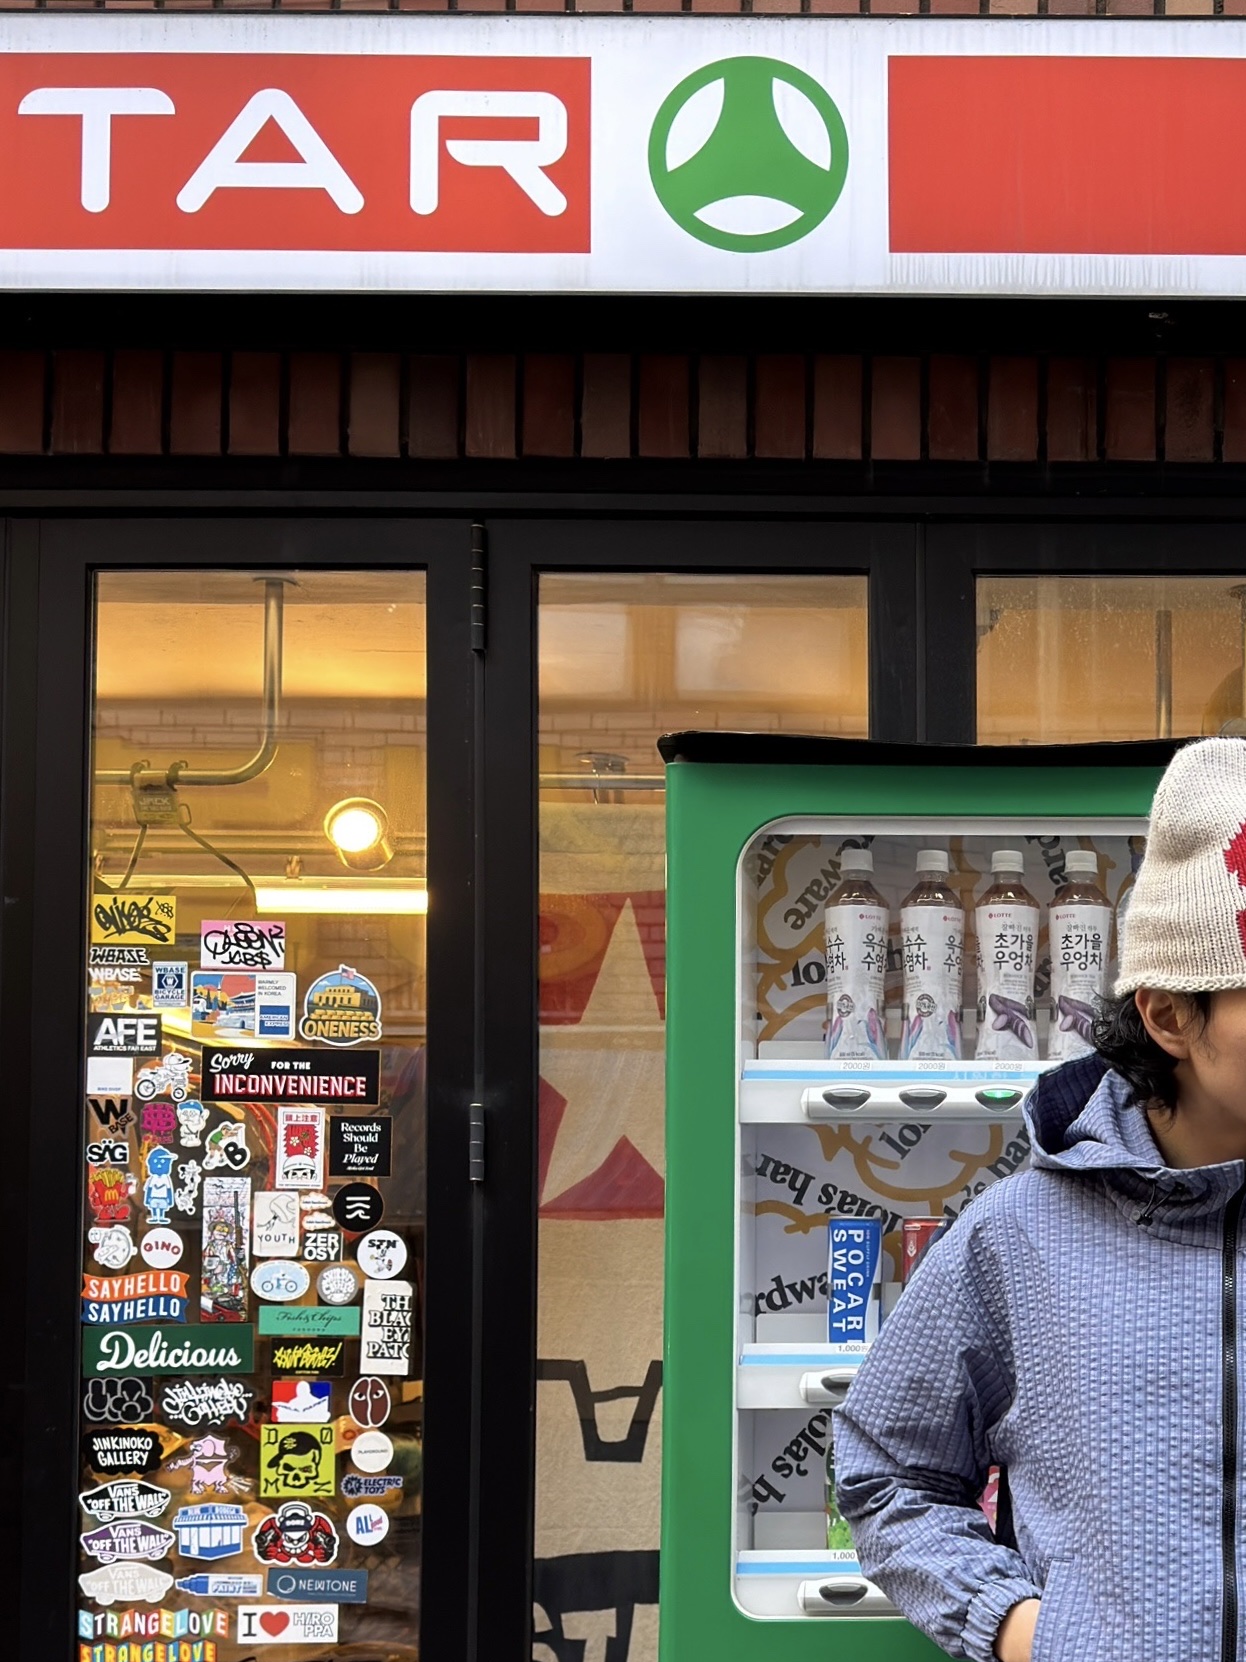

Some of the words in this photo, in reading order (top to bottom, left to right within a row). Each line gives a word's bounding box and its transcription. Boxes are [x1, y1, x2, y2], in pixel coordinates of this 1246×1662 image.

[18, 88, 567, 215] TAR
[993, 932, 1034, 951] 초가을
[1060, 933, 1103, 951] 초가을
[993, 951, 1033, 971] 우엉차
[1060, 951, 1103, 971] 우엉차
[155, 966, 186, 974] WBASE
[93, 1017, 157, 1046] AFE
[304, 1020, 378, 1038] ONENESS
[209, 1052, 255, 1073] Sorry
[270, 1061, 291, 1070] FOR
[292, 1061, 312, 1070] THE
[842, 1062, 870, 1070] 2000원
[918, 1062, 945, 1070] 2000원
[994, 1062, 1023, 1071] 2000원
[213, 1073, 367, 1097] INCONVENIENCE
[340, 1122, 382, 1132] Records
[343, 1133, 379, 1143] Should
[354, 1143, 368, 1154] Be
[342, 1153, 380, 1165] Played
[257, 1233, 296, 1244] YOUTH
[304, 1233, 339, 1247] ZER
[143, 1240, 181, 1255] GINO
[304, 1247, 339, 1261] OSY
[88, 1274, 181, 1300] SAYHELLO
[832, 1228, 848, 1333] SWEAT
[88, 1298, 181, 1323] SAYHELLO
[382, 1326, 411, 1343] EY
[96, 1330, 242, 1371] Delicious
[92, 1436, 153, 1451] JINKINOKO
[97, 1450, 149, 1467] GALLERY
[363, 1477, 402, 1488] ELECTRIC
[107, 1484, 140, 1498] VANS
[364, 1486, 386, 1495] TOYS
[112, 1496, 135, 1513] THE
[109, 1524, 142, 1538] VANS
[113, 1538, 137, 1553] THE
[298, 1579, 357, 1593] NEWTONE
[79, 1610, 228, 1638] STRANGELOVE
[242, 1612, 258, 1637] I
[304, 1624, 334, 1638] PPA
